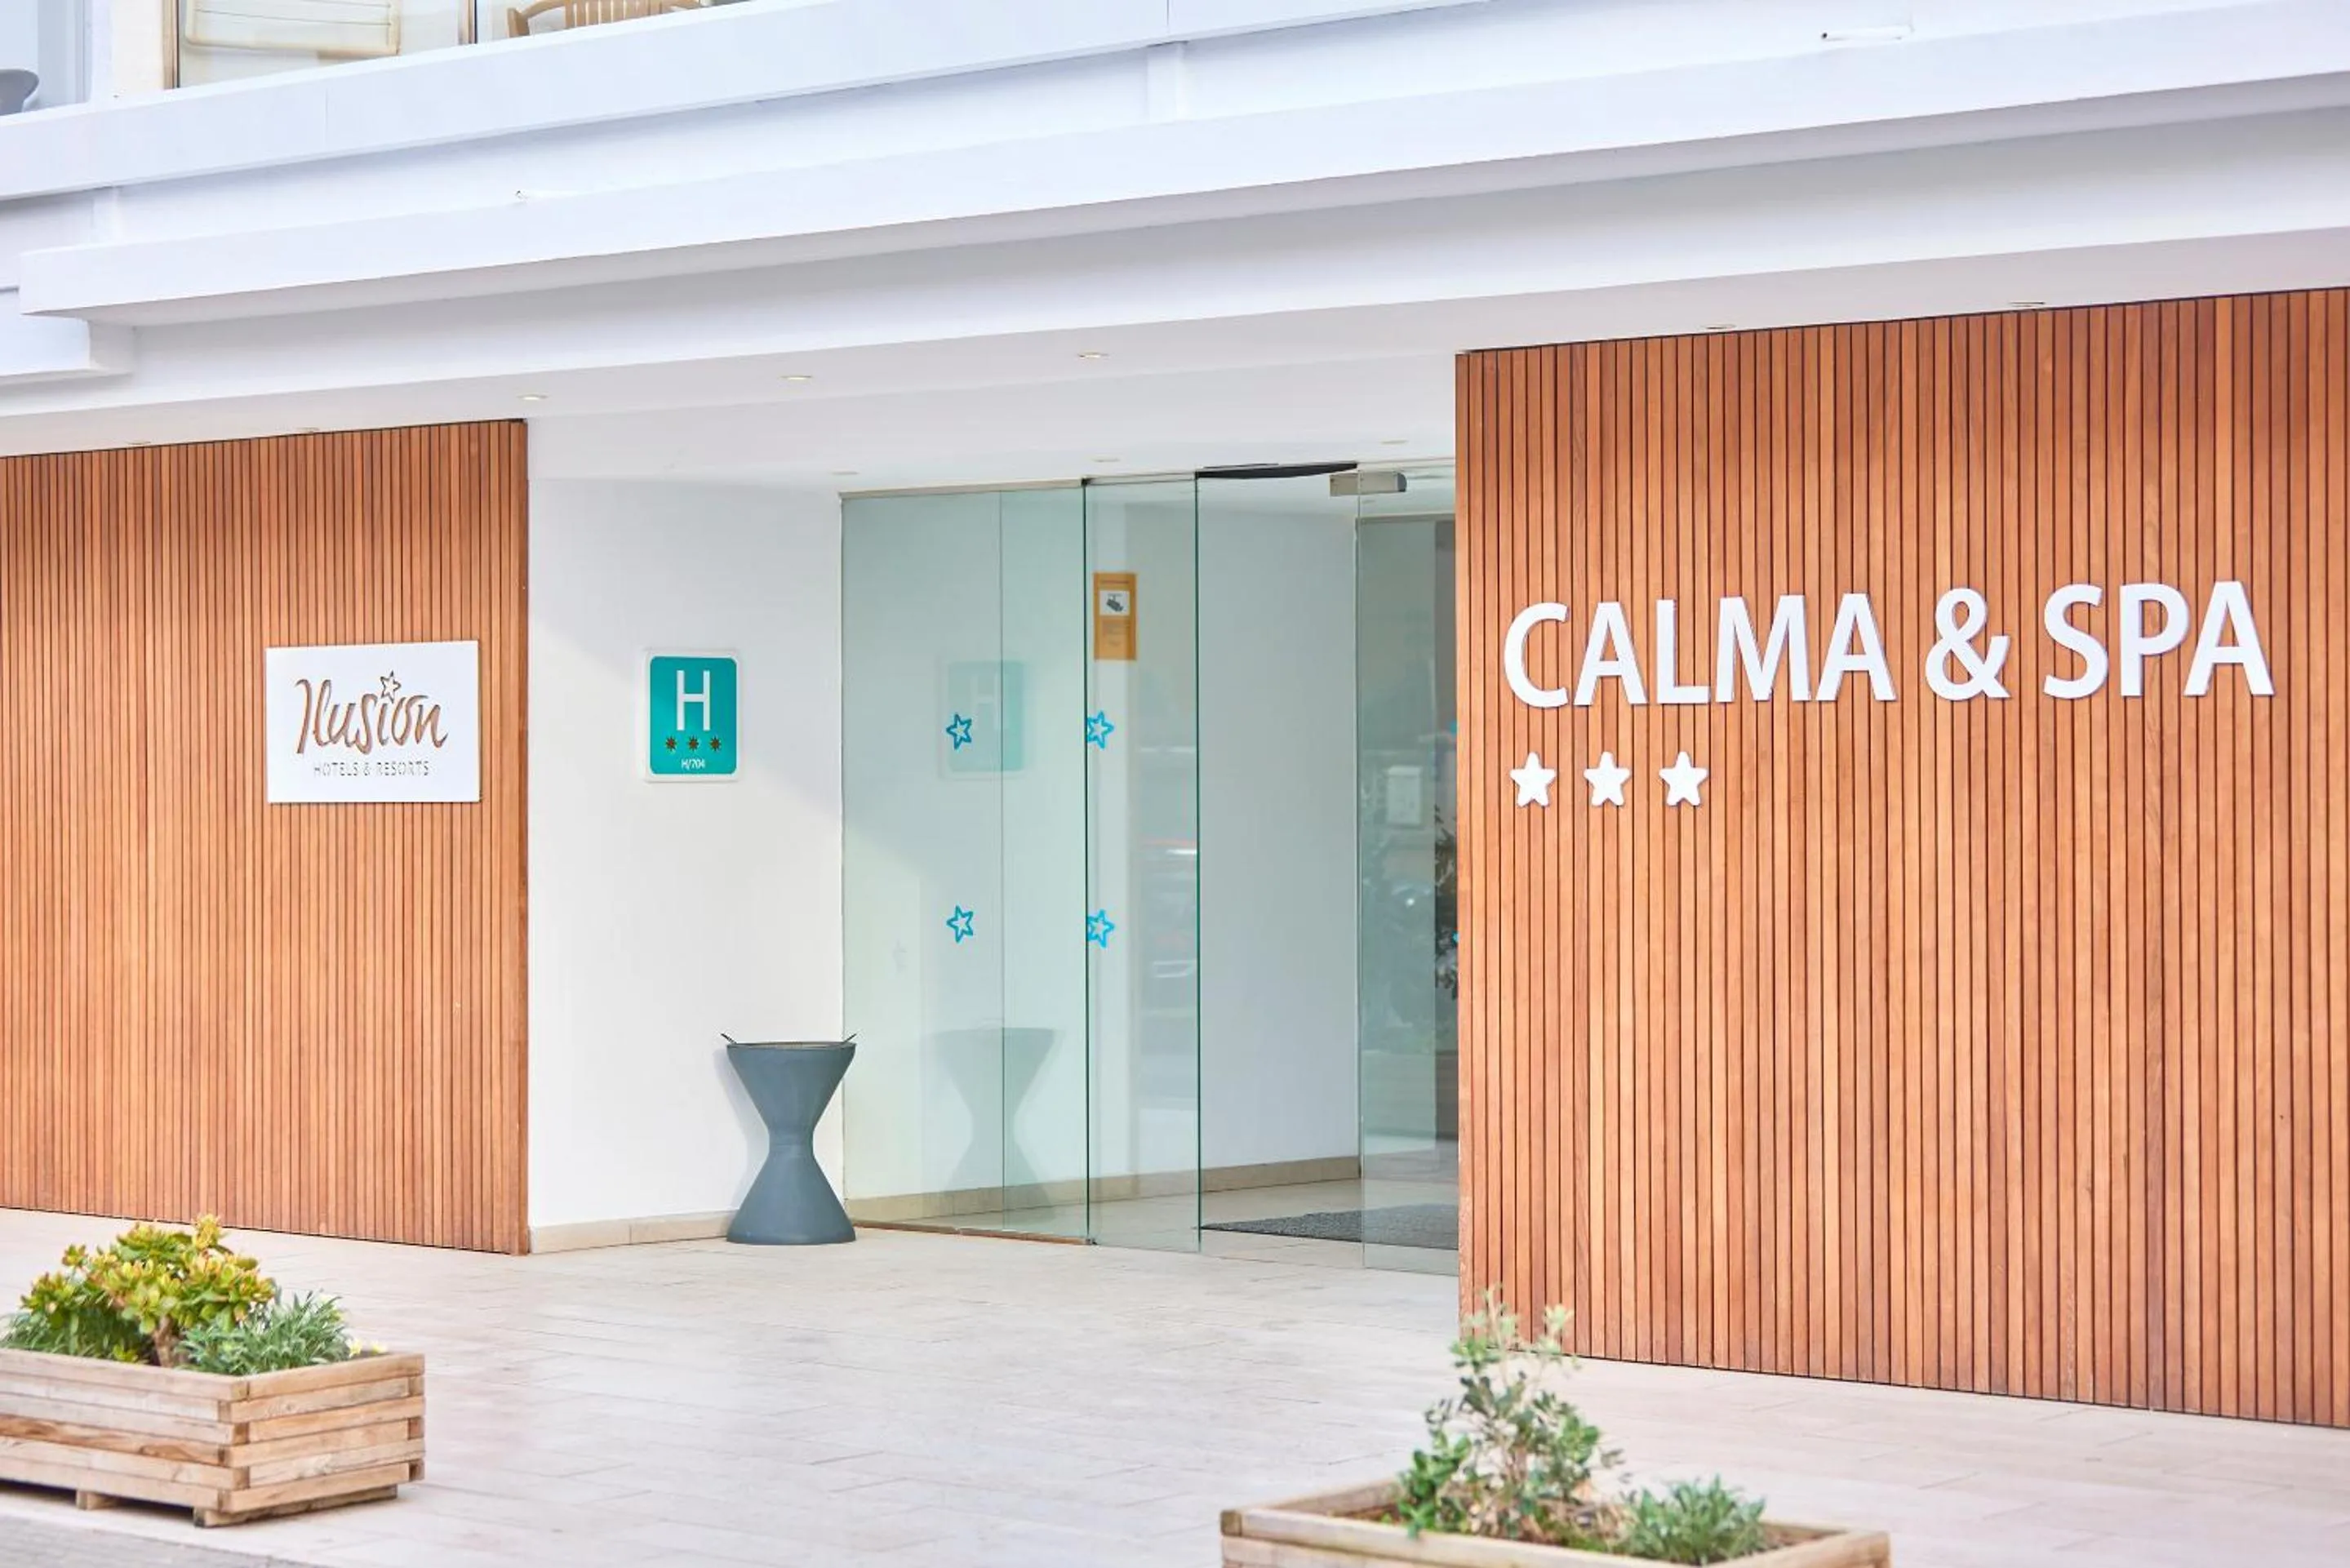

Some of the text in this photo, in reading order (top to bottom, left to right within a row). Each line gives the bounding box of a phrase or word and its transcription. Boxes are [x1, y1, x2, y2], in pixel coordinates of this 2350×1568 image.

[1503, 580, 2275, 708] CALMA & SPA
[676, 669, 711, 731] H
[313, 760, 429, 776] HOTELS & RESORTS
